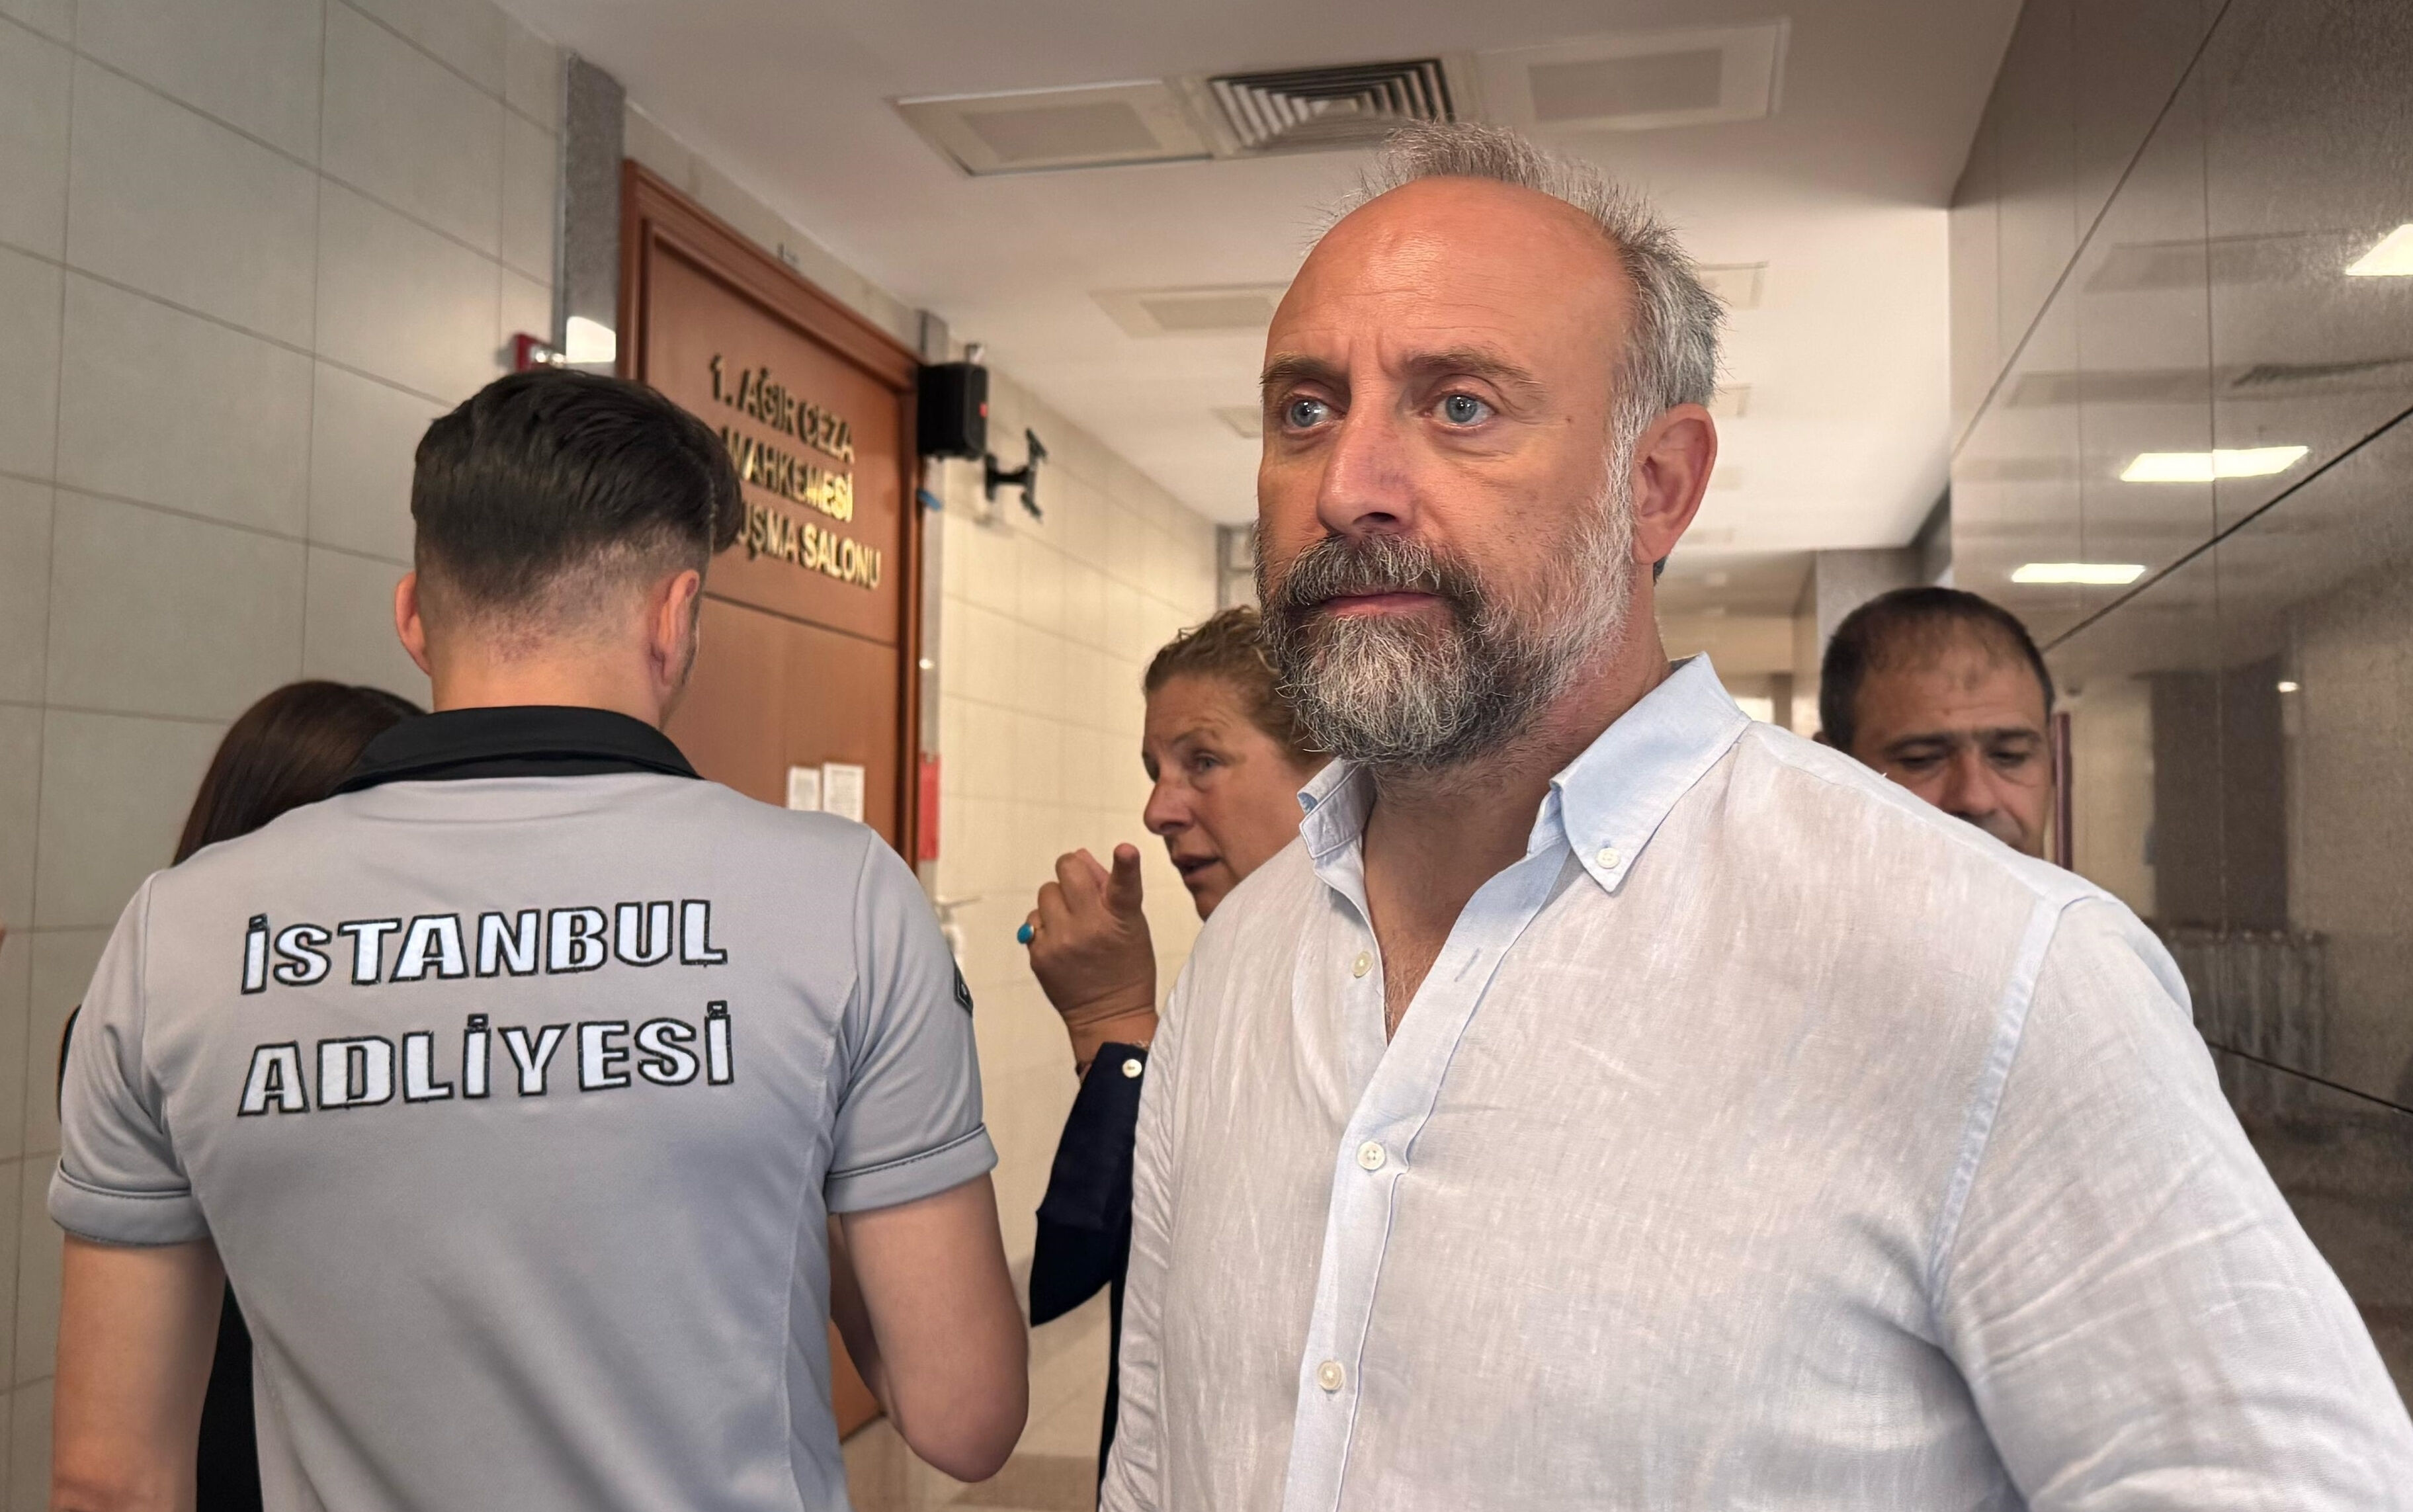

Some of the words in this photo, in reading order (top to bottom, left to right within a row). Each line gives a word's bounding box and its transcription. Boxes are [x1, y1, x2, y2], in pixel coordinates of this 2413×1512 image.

[710, 353, 732, 405] 1.
[738, 368, 793, 436] AĞIR
[797, 402, 855, 463] CEZA
[800, 523, 881, 589] SALONU
[241, 900, 728, 995] İSTANBUL
[238, 1000, 734, 1116] ADLİYESİ
